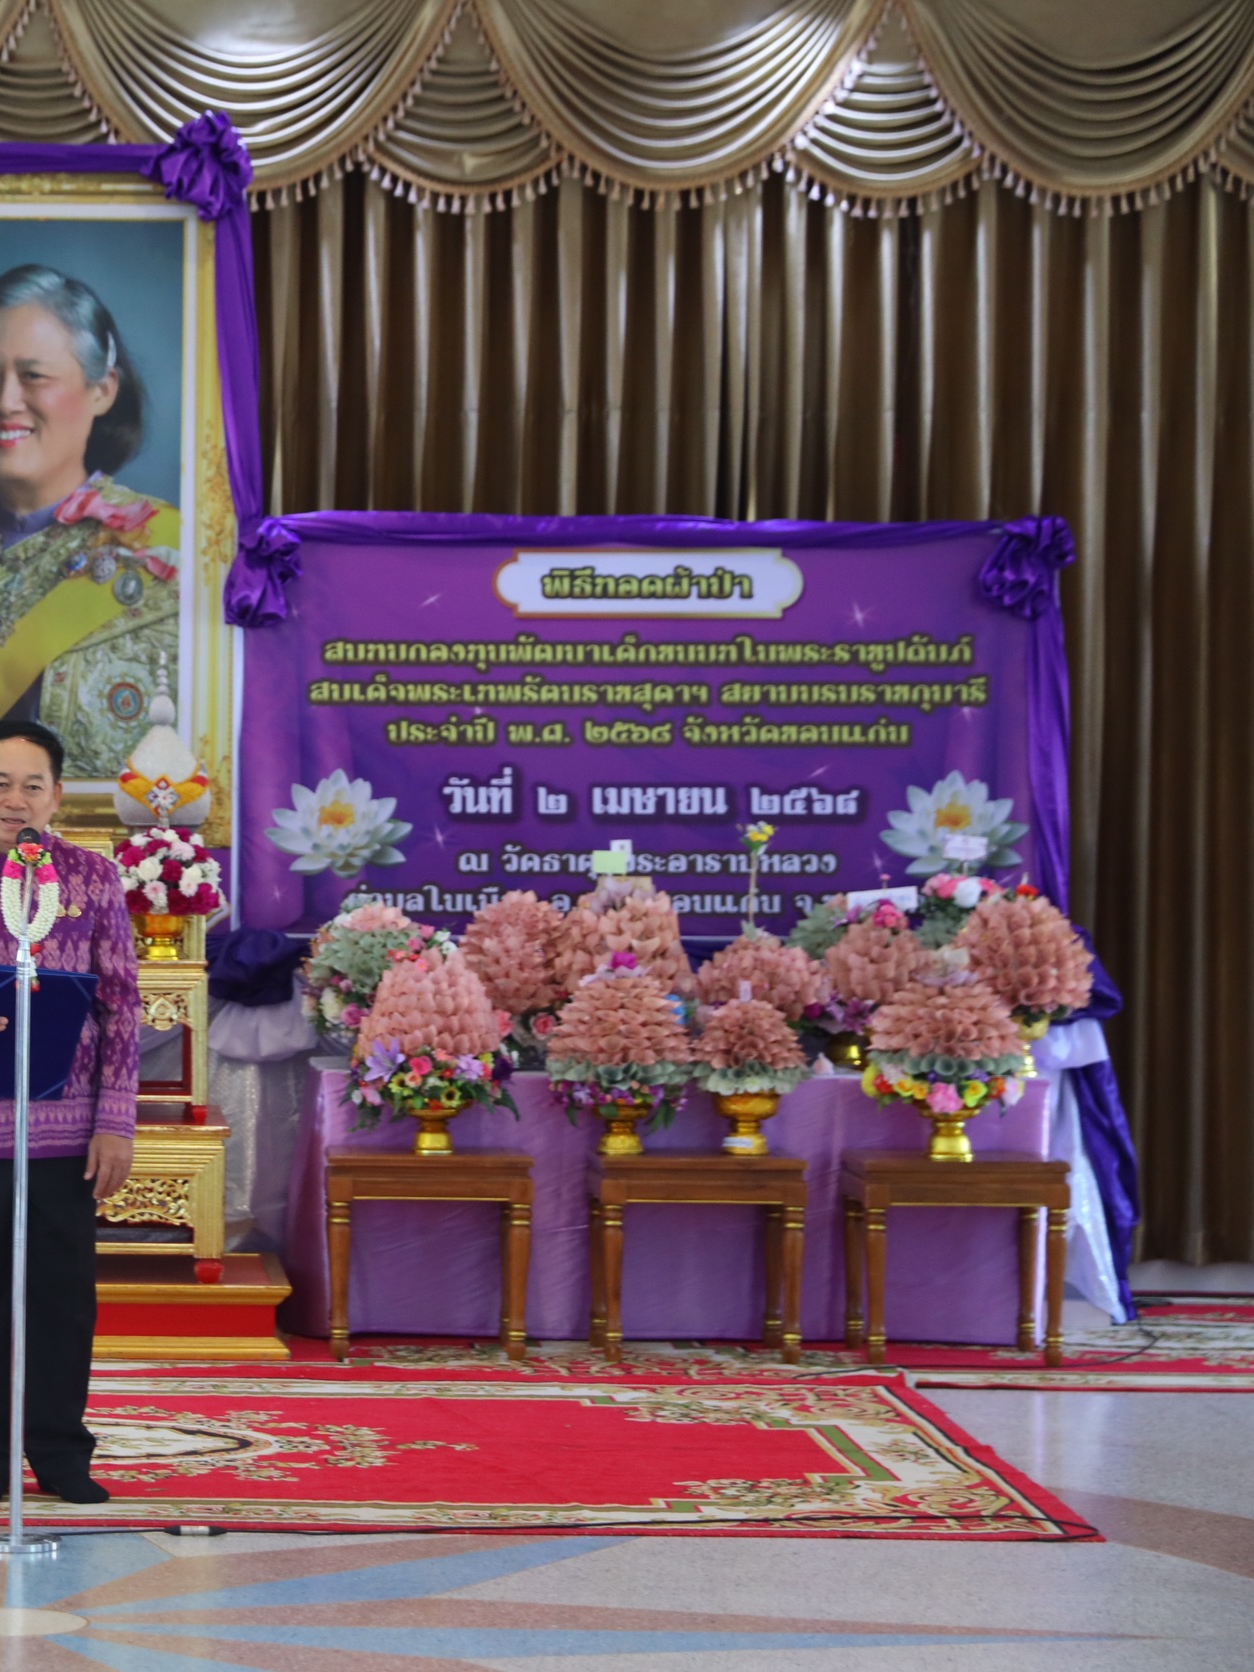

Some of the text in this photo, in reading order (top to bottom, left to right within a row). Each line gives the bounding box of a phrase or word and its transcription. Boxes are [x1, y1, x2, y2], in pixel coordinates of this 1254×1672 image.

[542, 567, 753, 599] พิธีทอดผ้าป่า
[324, 634, 973, 672] สมทบกองทุนพัฒนาเด็กชนบทในพระราชูปถัมภ์
[309, 674, 988, 712] สมเด็จพระเทพรัตนราชสุดาฯ สยามบรมราชกุมารี
[387, 715, 911, 744] ประจำปี พ.ศ. ๒๕๖๘ จังหวัดขอนแก่น
[443, 767, 860, 815] วันที่ ๒ เมษายน ๒๕๖๘
[458, 852, 490, 873] ณ
